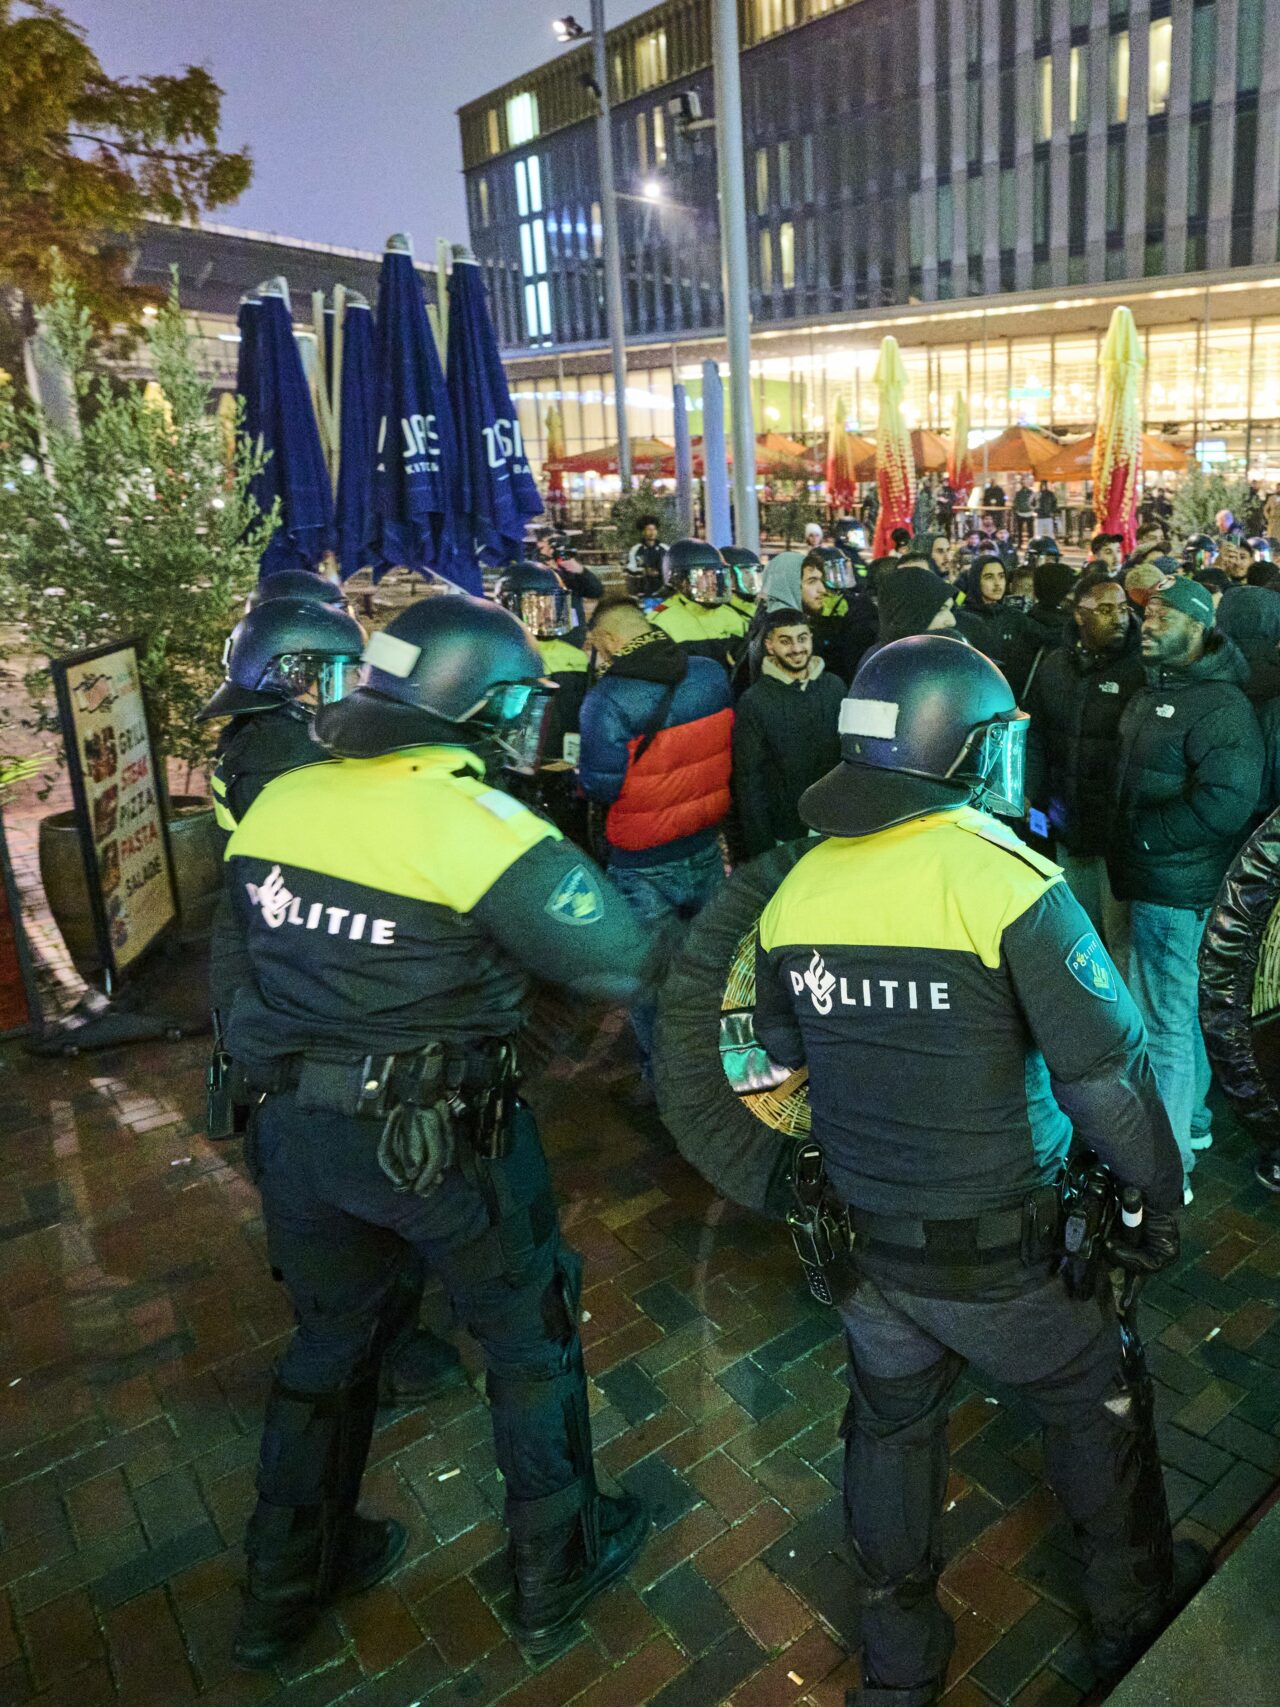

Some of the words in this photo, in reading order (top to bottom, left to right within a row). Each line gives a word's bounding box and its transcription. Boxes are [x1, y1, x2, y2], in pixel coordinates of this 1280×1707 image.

[119, 787, 154, 828] PIZZA
[120, 821, 158, 859] PASTA
[789, 952, 951, 1016] POLITIE
